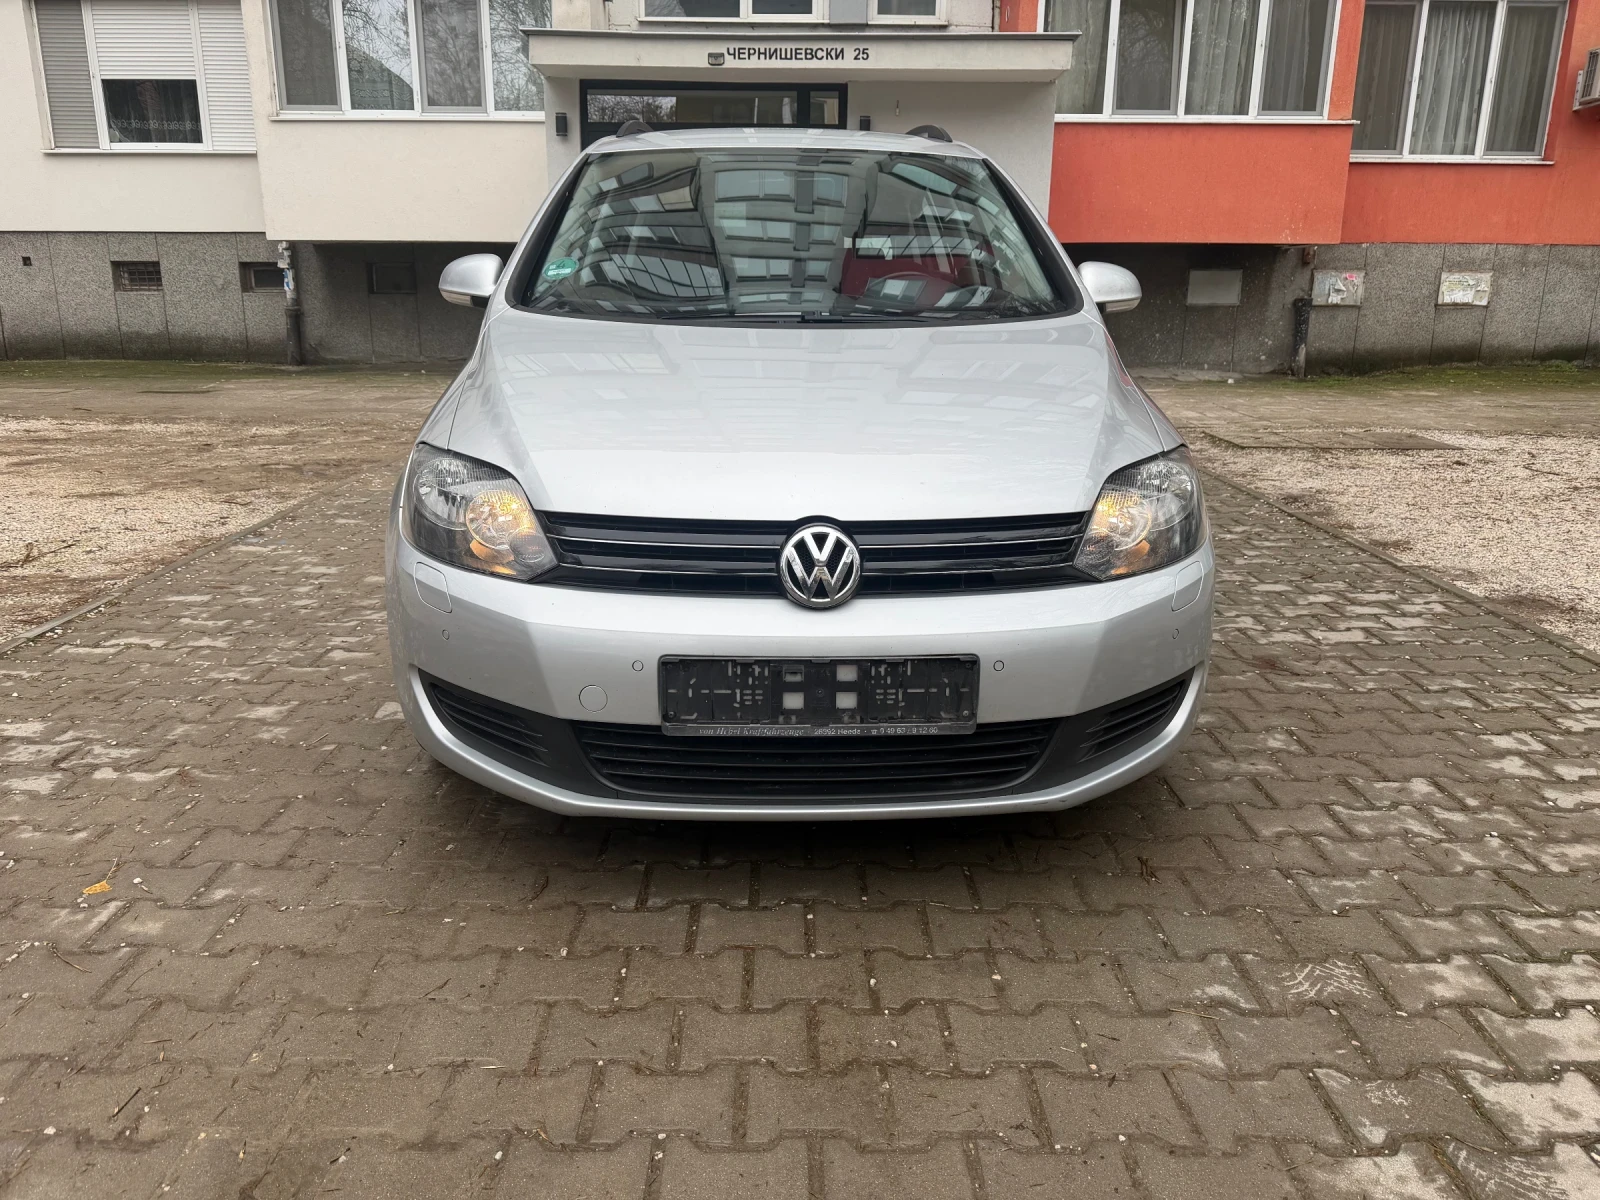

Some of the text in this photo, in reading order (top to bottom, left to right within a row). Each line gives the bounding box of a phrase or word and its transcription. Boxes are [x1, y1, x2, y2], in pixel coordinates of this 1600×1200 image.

[726, 47, 870, 61] ЧЕРНИШЕВСКИ 25
[782, 526, 860, 606] VW
